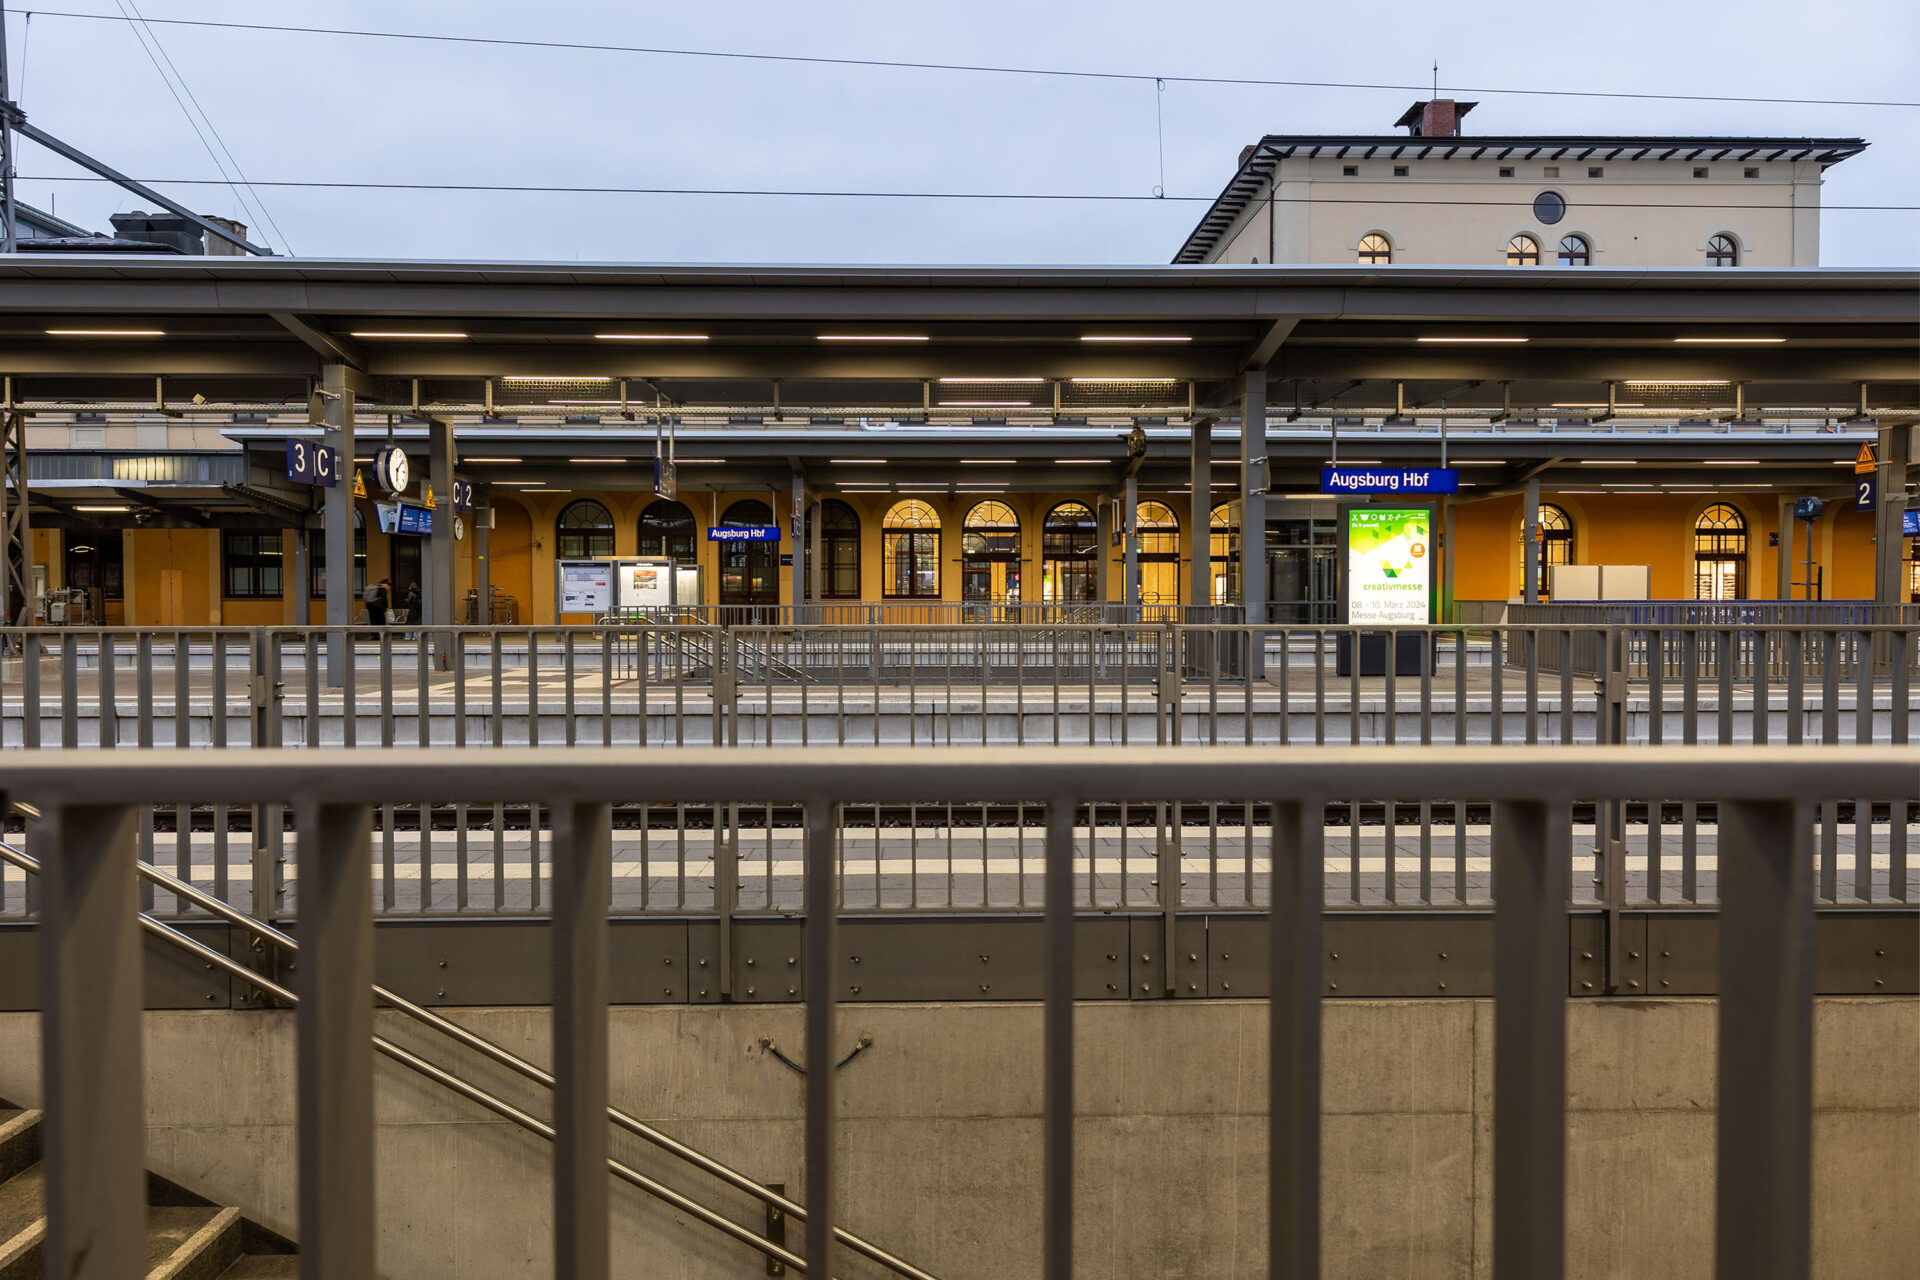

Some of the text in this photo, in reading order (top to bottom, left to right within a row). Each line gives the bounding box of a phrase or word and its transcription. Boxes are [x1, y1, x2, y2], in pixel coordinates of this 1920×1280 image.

[294, 443, 306, 473] 3
[1329, 472, 1429, 489] Augsburg Hbf
[453, 482, 472, 506] C 2
[1859, 483, 1870, 504] 2
[712, 529, 765, 539] Augsburg Hbf
[1363, 583, 1423, 591] creativmesse
[1379, 611, 1415, 621] Augsburg
